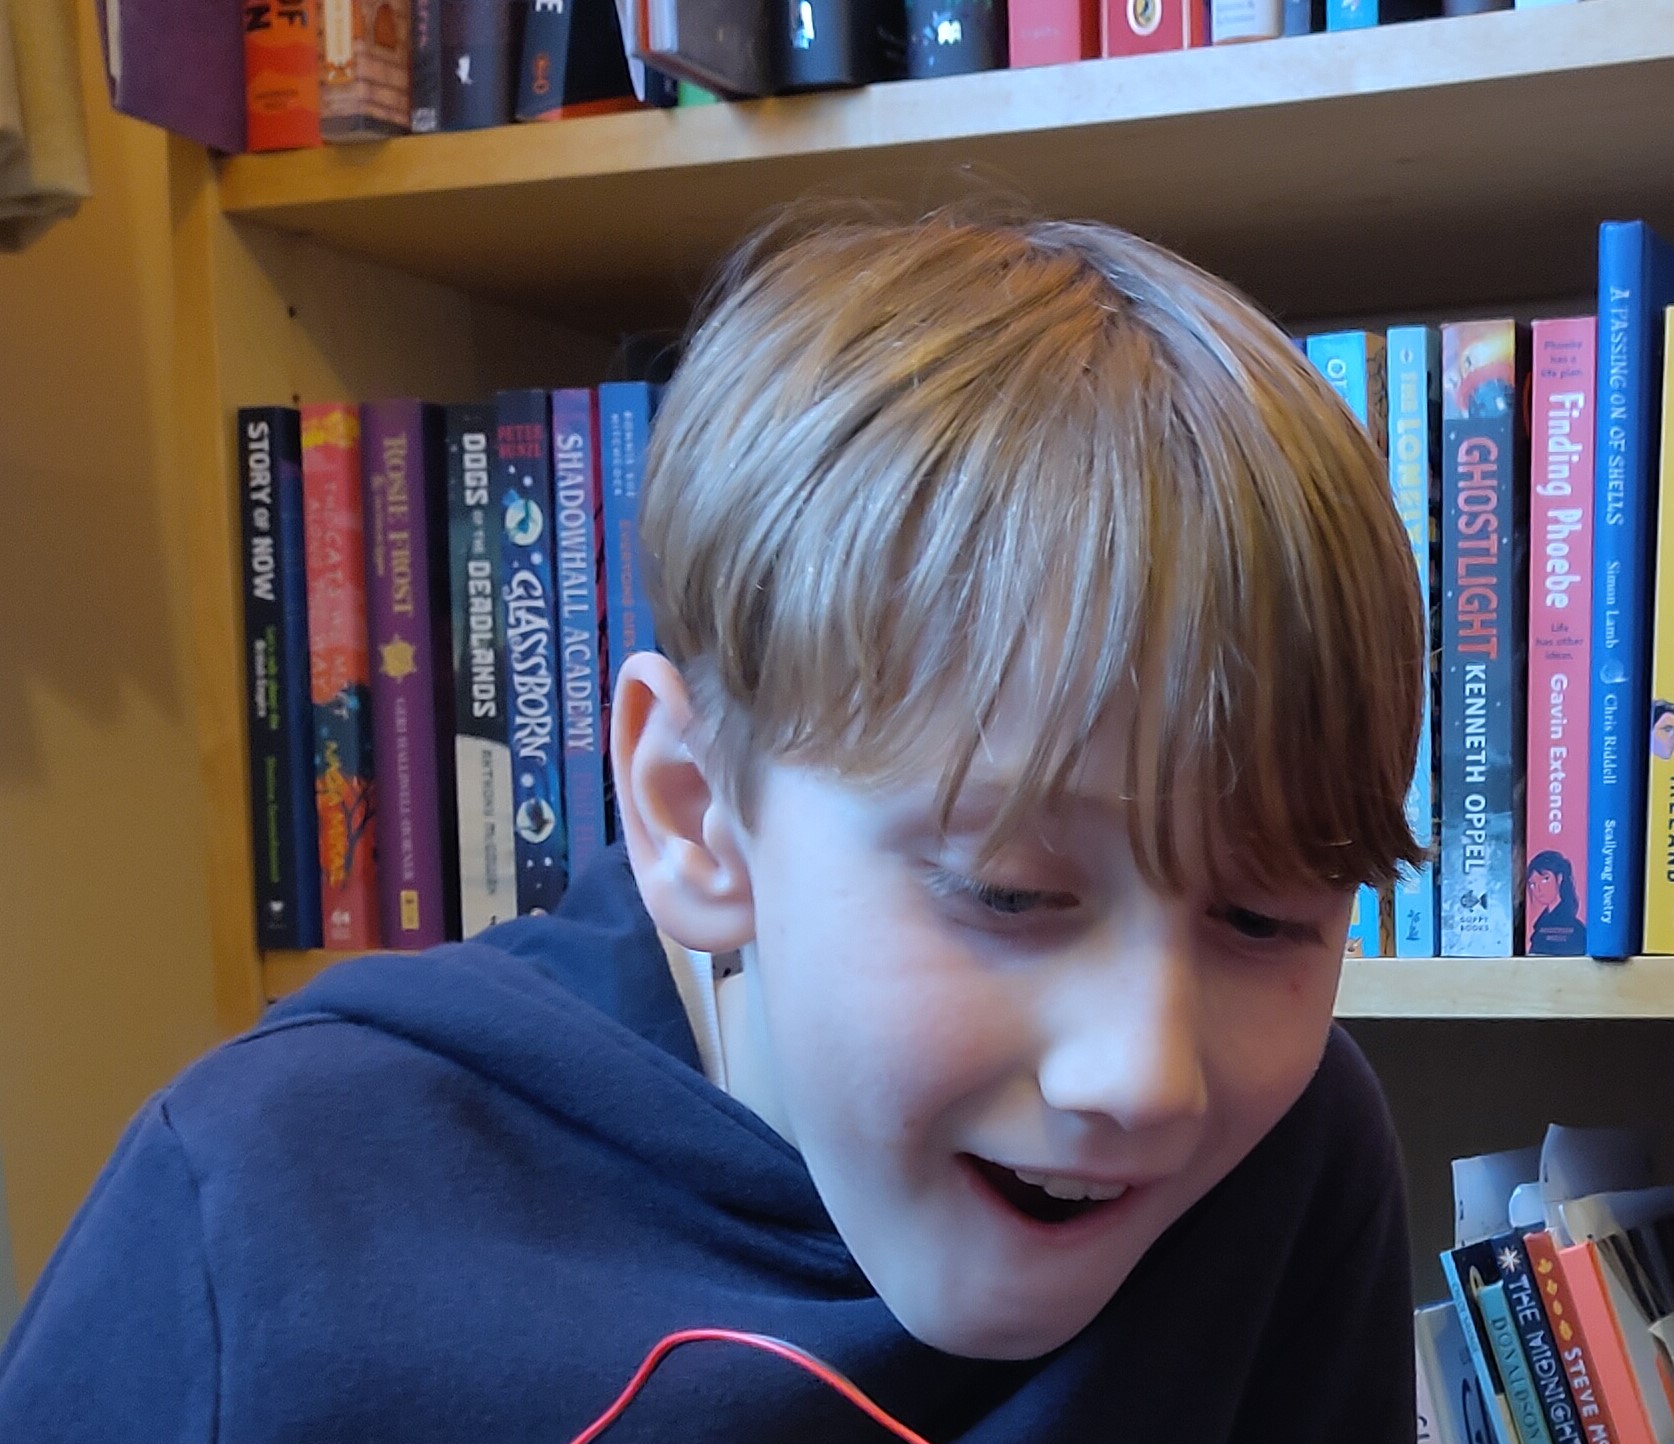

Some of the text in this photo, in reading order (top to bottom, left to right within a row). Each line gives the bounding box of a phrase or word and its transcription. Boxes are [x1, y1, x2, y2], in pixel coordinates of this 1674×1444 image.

[247, 421, 271, 504] STORY
[1605, 286, 1629, 525] A PASSING ON OF SHELLS
[462, 433, 489, 506] DOGS
[557, 433, 589, 619] SHADOWHALL
[1537, 392, 1585, 609] Finding Phoebe
[251, 538, 276, 601] NOW
[389, 531, 414, 616] FROST
[1457, 437, 1498, 660] GHOSTLIGHT
[1604, 561, 1621, 648] Simon Lamb
[468, 560, 497, 718] DEADLANDS
[503, 569, 553, 764] GLASSBORN
[563, 627, 595, 752] ACADEMY
[1463, 664, 1487, 873] KENNETH OPPEL
[1548, 673, 1569, 834] Gavin Extence
[1601, 694, 1618, 784] Chris Riddell
[1600, 819, 1617, 924] Scallywag Poetry
[1508, 1273, 1542, 1326] THE
[1563, 1346, 1600, 1418] STEVE
